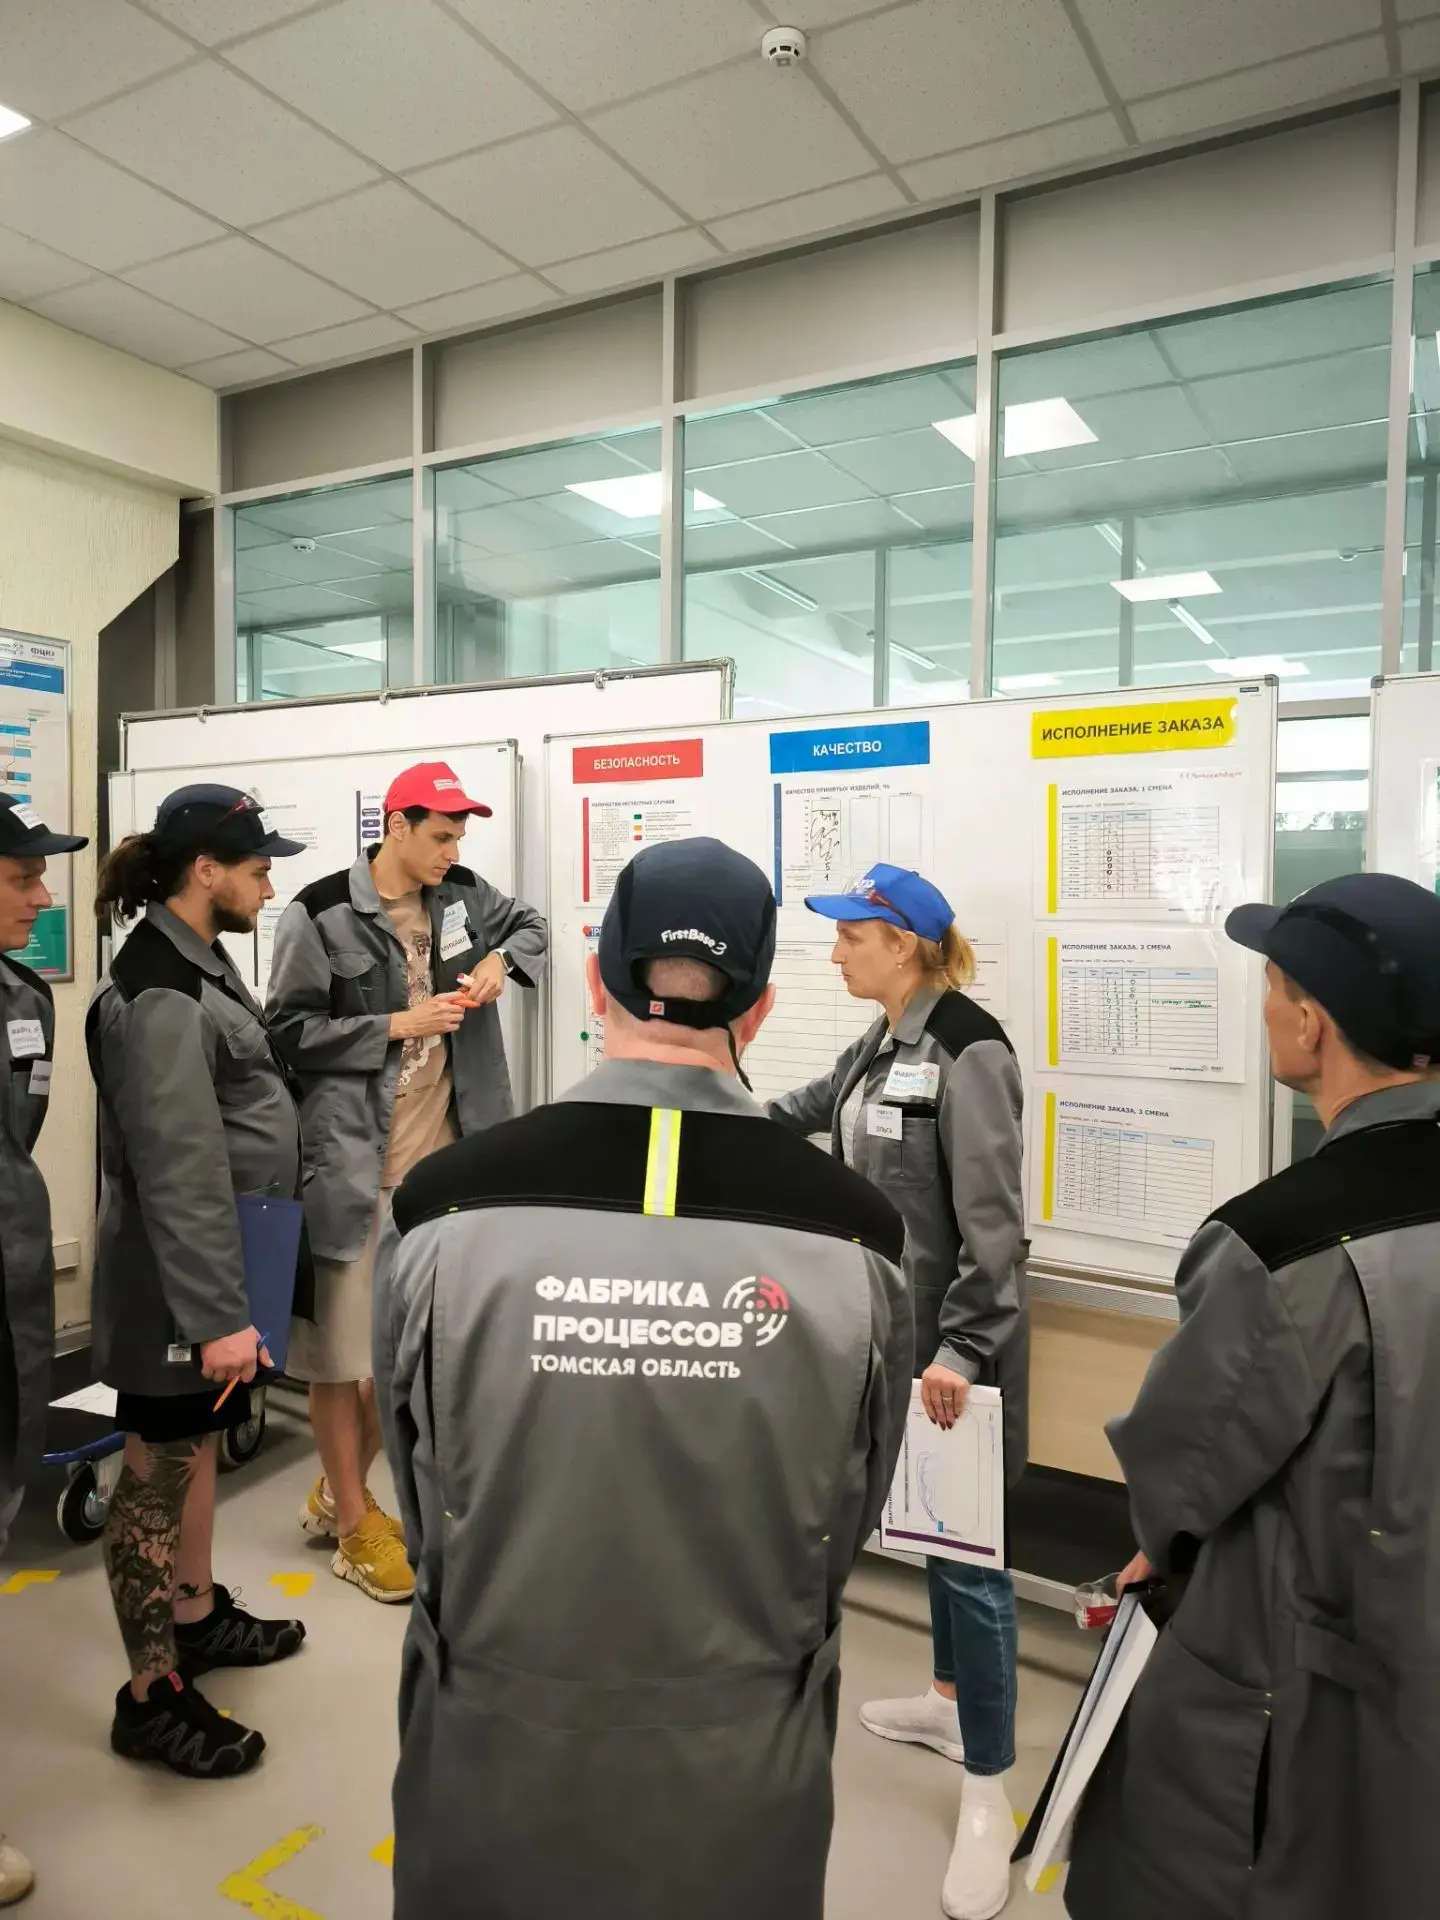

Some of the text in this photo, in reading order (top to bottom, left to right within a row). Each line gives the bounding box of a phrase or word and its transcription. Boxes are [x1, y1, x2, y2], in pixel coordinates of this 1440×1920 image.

[1041, 715, 1225, 742] ИСПОЛНЕНИЕ ЗАКАЗА
[812, 740, 882, 757] КАЧЕСТВО
[593, 754, 681, 770] БЕЗОПАСНОСТЬ
[1062, 787, 1109, 796] ИСПОЛНЕНИЕ
[1147, 784, 1173, 792] СМЕНА
[1060, 1100, 1106, 1111] ИСПОЛНЕНИЕ
[1144, 1109, 1169, 1118] СМЕНА
[535, 1275, 710, 1308] ФАБРИКА
[533, 1314, 743, 1349] ПРОЦЕССОВ
[530, 1354, 741, 1379] ТОМСКАЯ ОБЛАСТЬ
